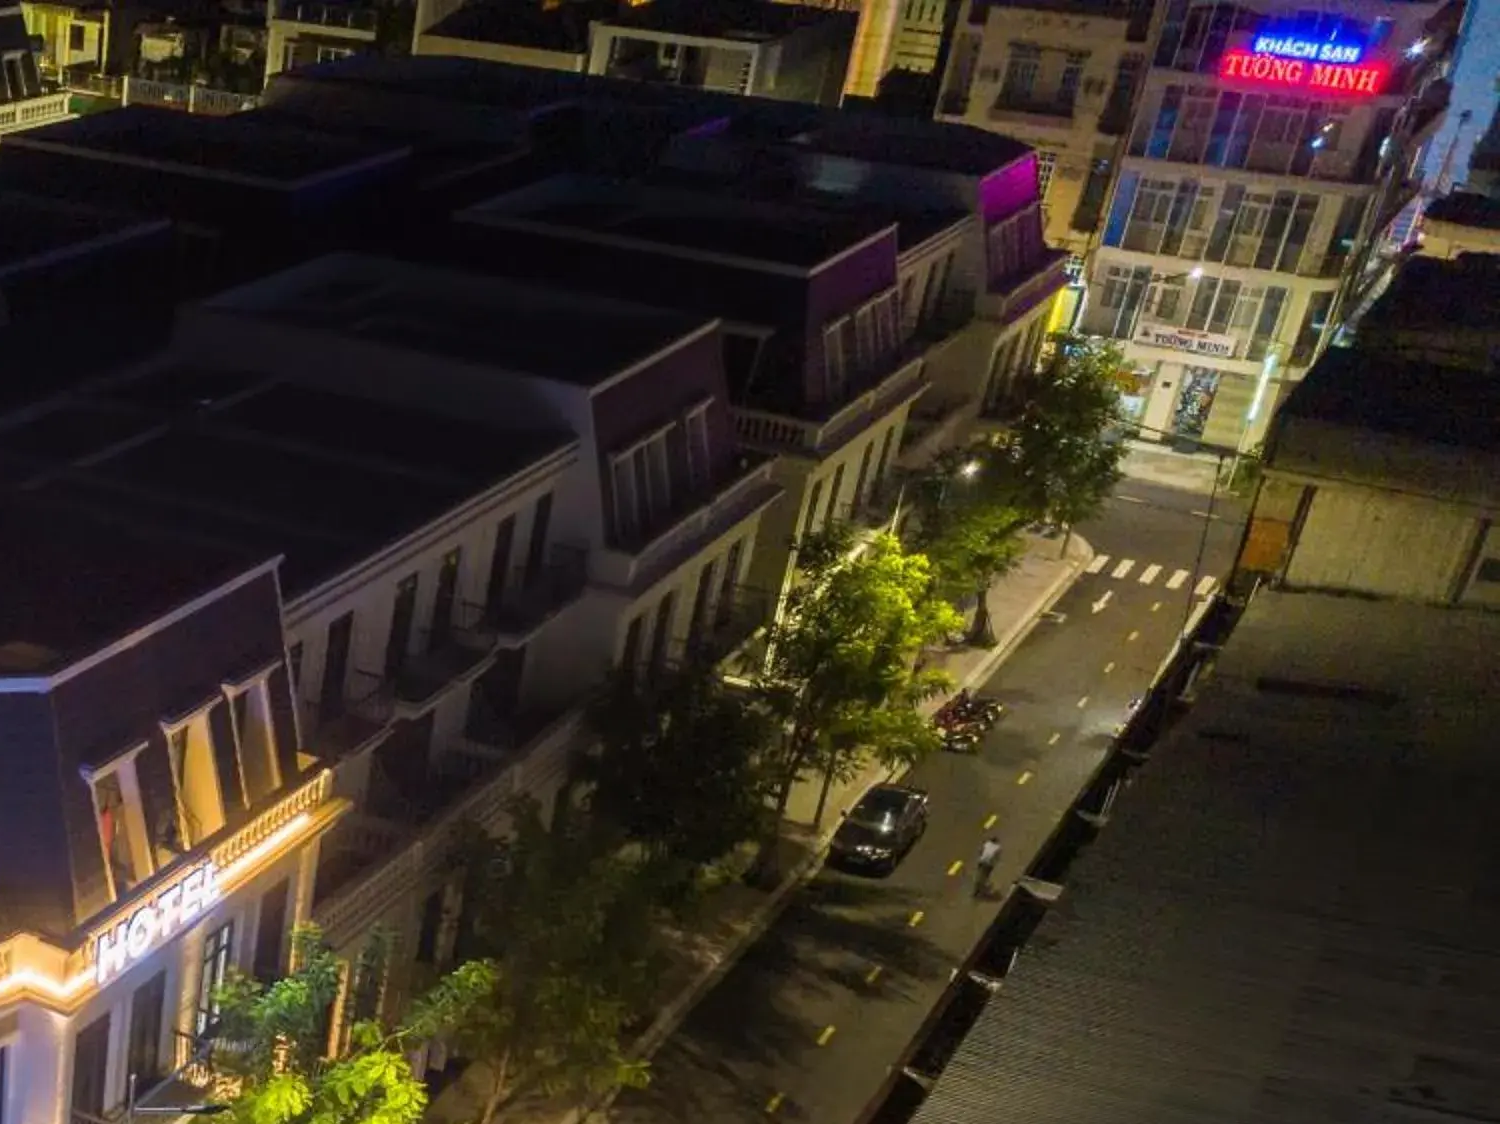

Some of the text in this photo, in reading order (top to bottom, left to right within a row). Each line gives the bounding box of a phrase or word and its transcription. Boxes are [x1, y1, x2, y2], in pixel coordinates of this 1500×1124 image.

[1256, 37, 1318, 58] KHÁCH
[1310, 64, 1378, 92] MINH
[96, 862, 220, 985] HOTEL
